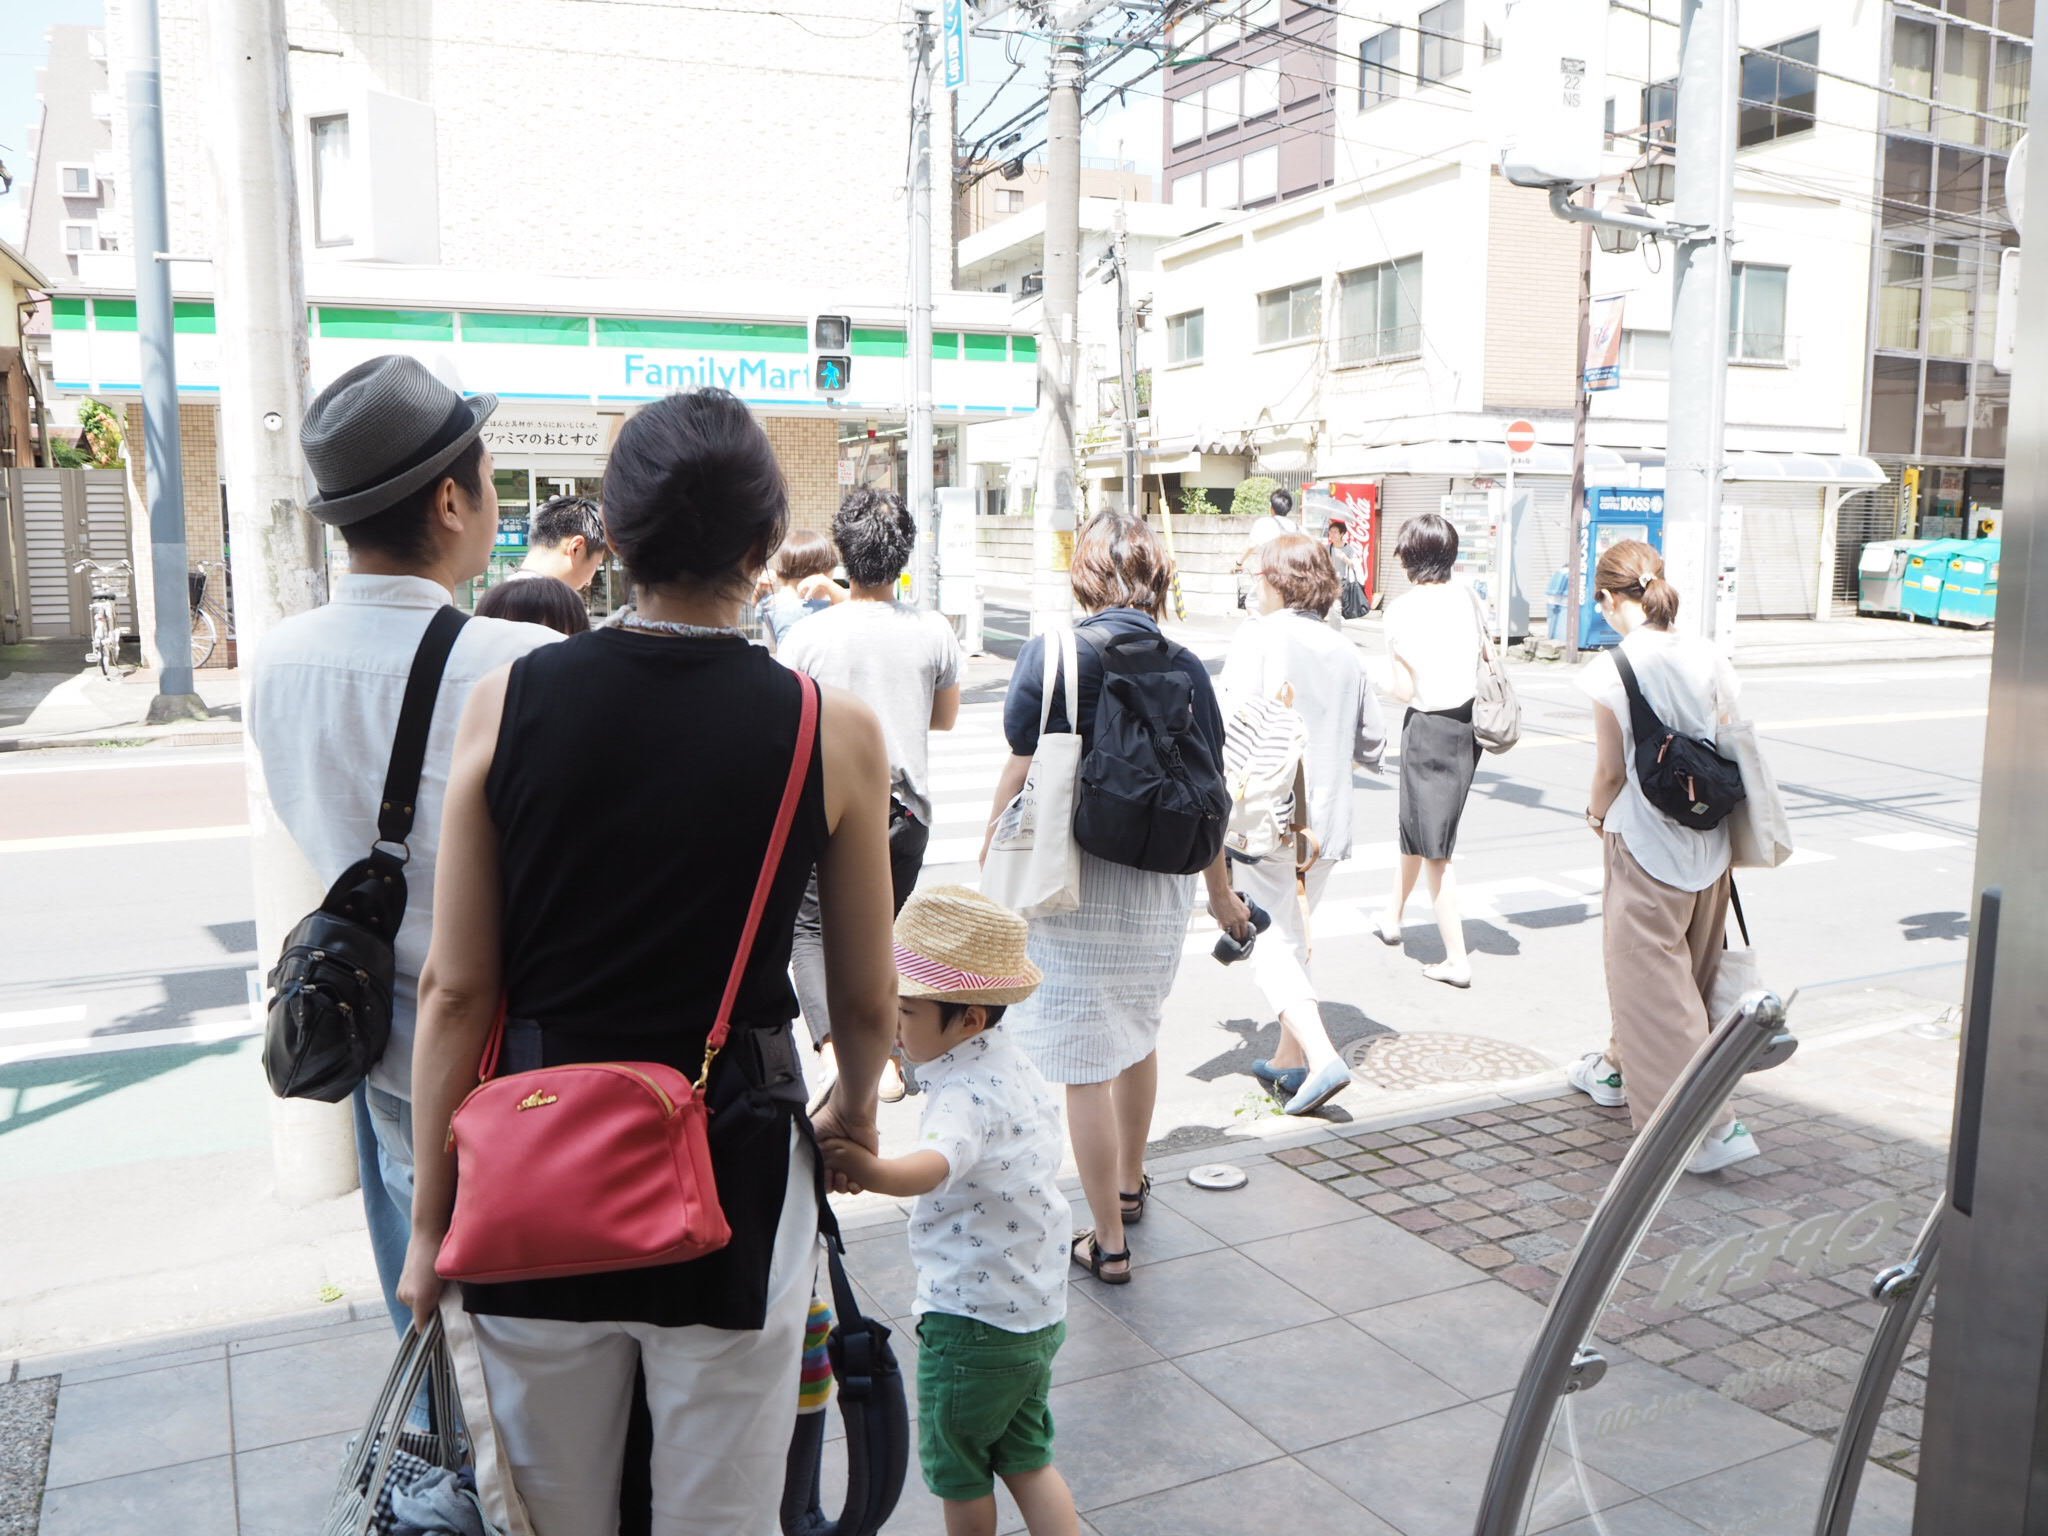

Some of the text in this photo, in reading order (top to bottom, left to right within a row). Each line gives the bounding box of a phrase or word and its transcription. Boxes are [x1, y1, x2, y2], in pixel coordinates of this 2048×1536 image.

[1564, 75, 1580, 90] 22
[1563, 92, 1580, 107] NS
[483, 432, 598, 446] ファミマのおむすび
[1620, 496, 1650, 511] BOSS
